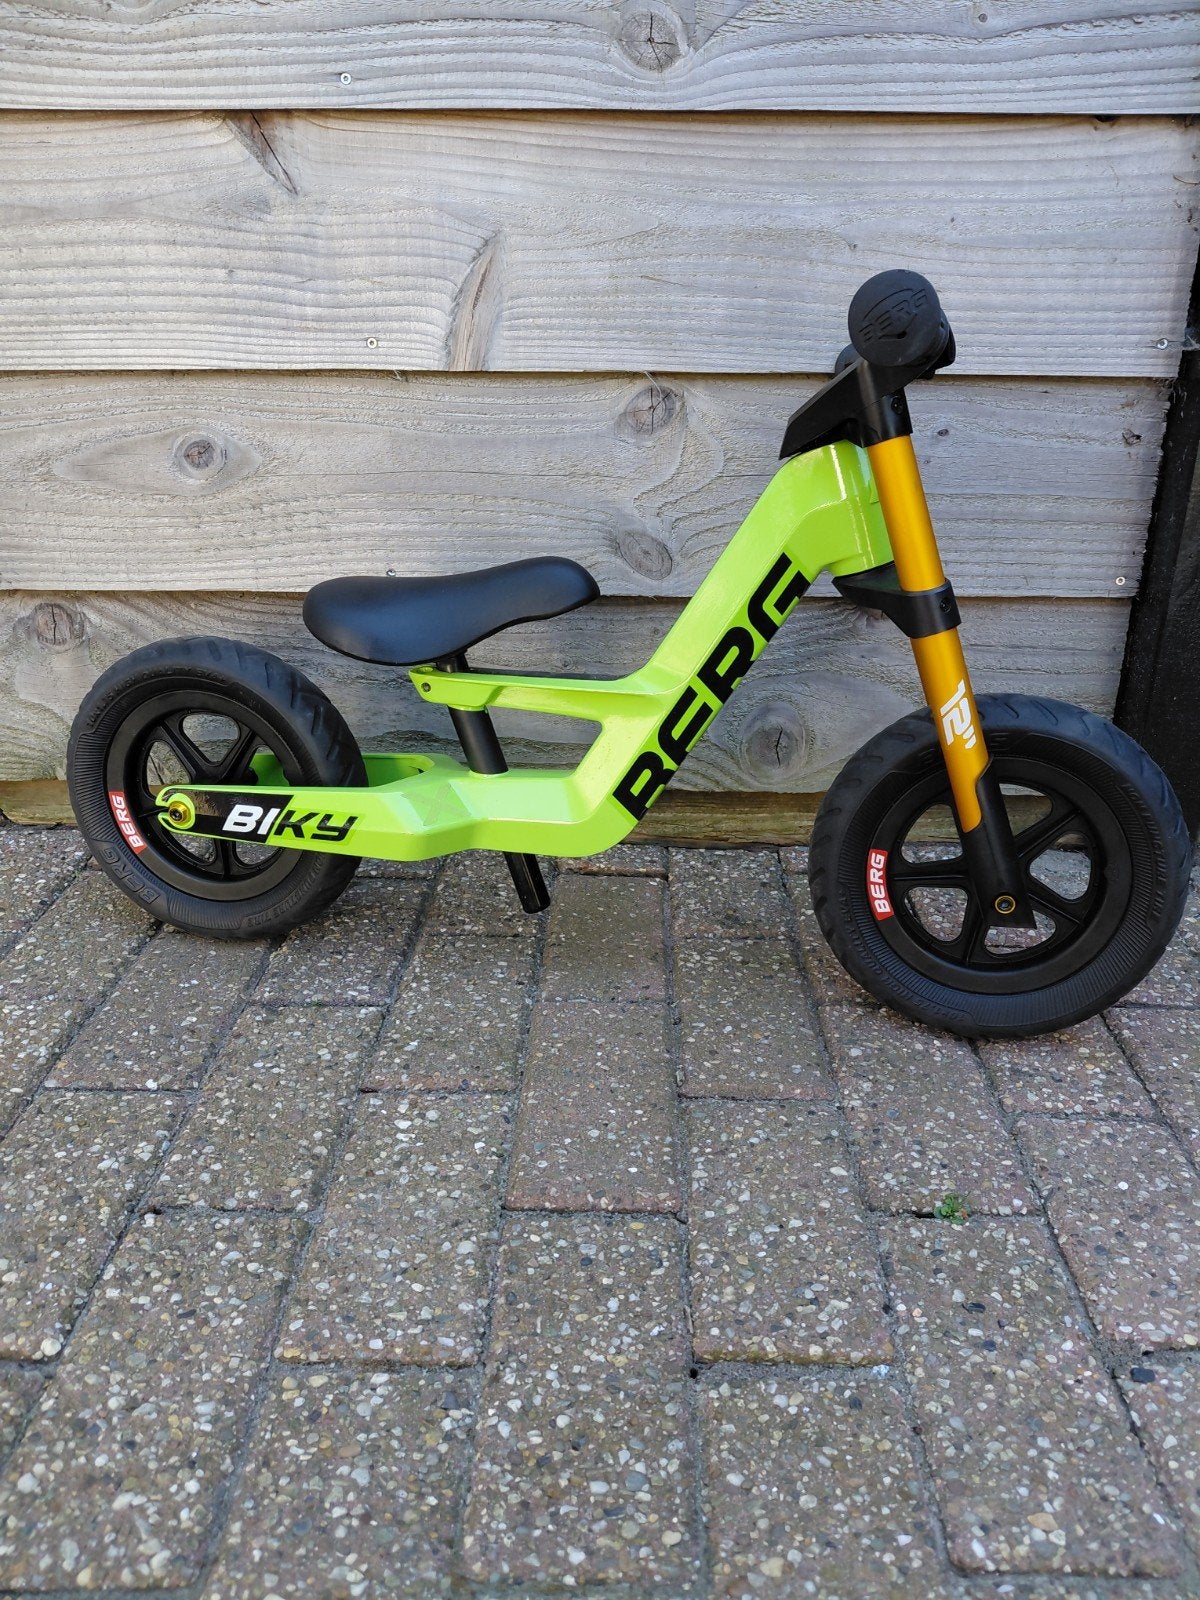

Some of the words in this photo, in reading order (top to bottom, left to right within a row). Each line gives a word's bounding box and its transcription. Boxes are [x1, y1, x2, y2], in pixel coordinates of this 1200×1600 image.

[612, 552, 811, 821] BERG
[112, 795, 144, 848] BERG
[870, 851, 892, 913] BERG
